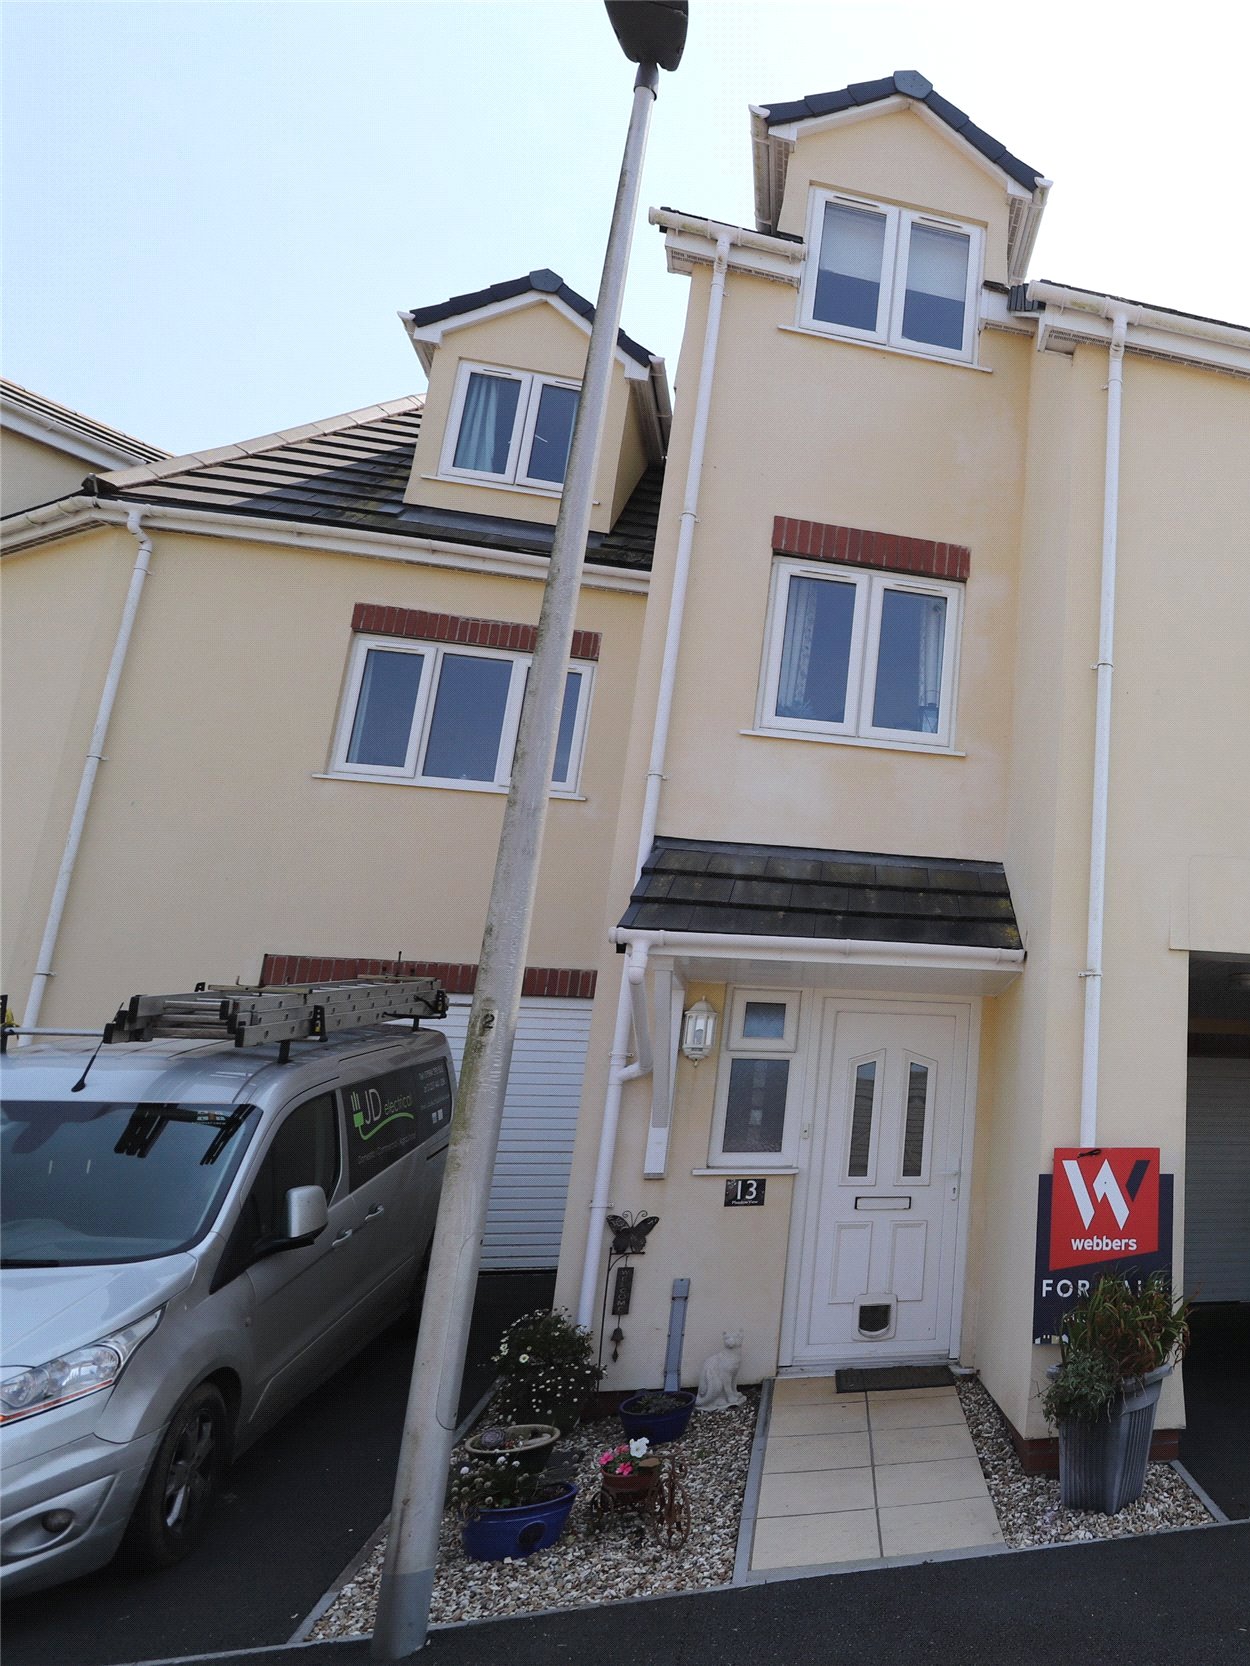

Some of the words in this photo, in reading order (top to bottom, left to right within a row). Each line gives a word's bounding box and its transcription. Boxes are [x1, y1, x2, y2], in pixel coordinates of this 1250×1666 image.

[484, 1014, 495, 1029] 2
[365, 1088, 382, 1124] JD
[736, 1180, 757, 1200] 13
[1071, 1235, 1137, 1251] webbers
[1042, 1279, 1090, 1298] FOR
